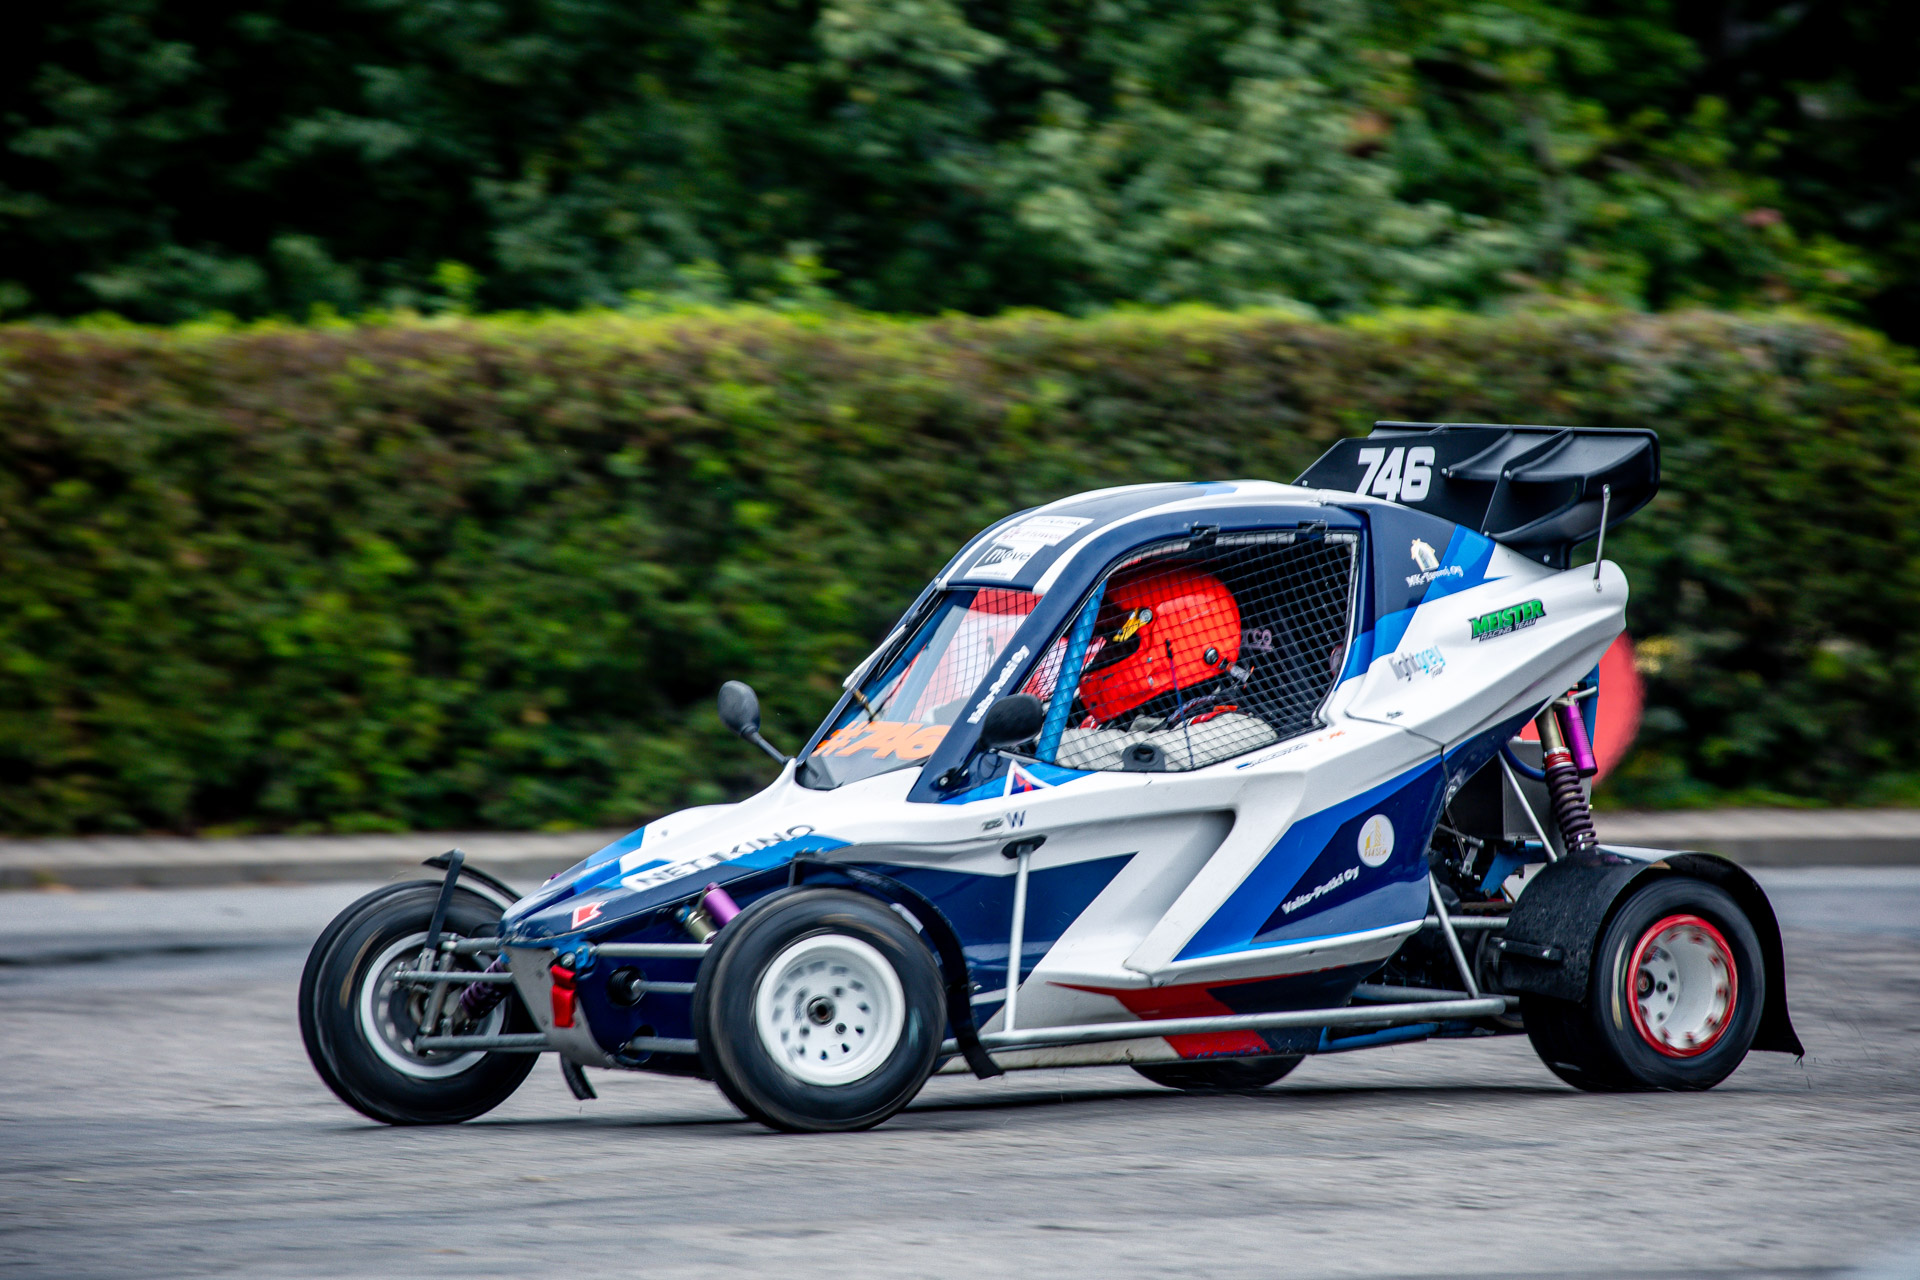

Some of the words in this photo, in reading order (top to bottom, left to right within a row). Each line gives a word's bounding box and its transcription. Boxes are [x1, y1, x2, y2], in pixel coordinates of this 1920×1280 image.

[1356, 446, 1435, 502] 746
[1469, 599, 1545, 639] MEISTER
[1480, 626, 1512, 641] RACING
[1515, 619, 1536, 631] TEAM
[1343, 866, 1360, 882] Oy
